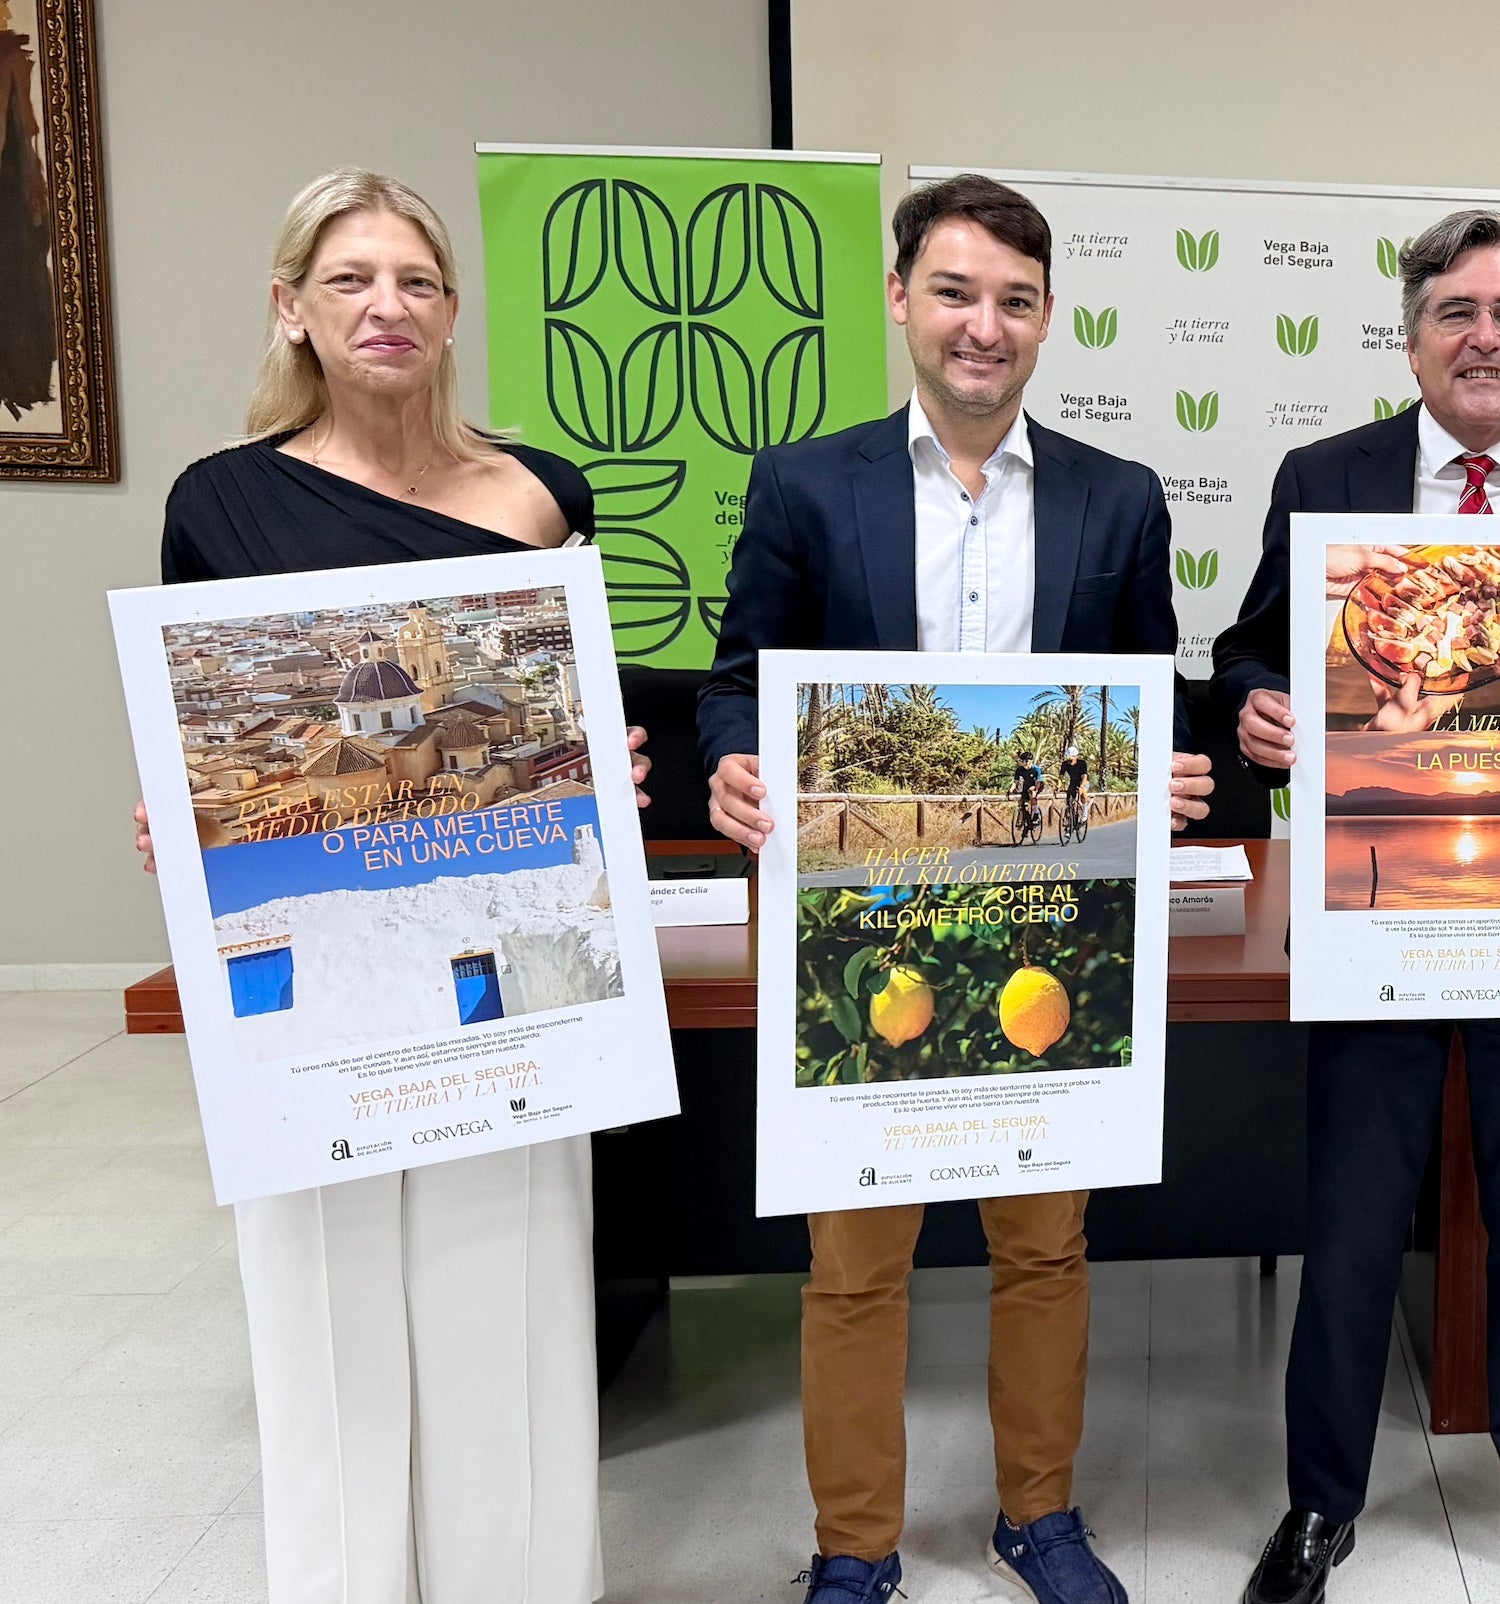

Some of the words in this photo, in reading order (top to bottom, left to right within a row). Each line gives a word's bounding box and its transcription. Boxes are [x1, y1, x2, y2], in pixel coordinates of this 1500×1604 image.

[1089, 232, 1128, 245] tierra
[1264, 240, 1296, 252] Vega
[1300, 241, 1329, 254] Baja
[1066, 248, 1075, 259] y
[1080, 246, 1092, 258] la
[1096, 246, 1122, 258] mía
[1264, 254, 1284, 266] del
[1288, 255, 1333, 268] Segura
[1192, 318, 1229, 330] tierra
[1362, 324, 1394, 337] Vega
[1168, 334, 1178, 344] y
[1182, 332, 1194, 342] la
[1199, 332, 1224, 344] mía
[1362, 338, 1382, 350] del
[1060, 394, 1093, 406] Vega
[1098, 395, 1128, 408] Baja
[1291, 402, 1328, 414] tierra
[1060, 408, 1080, 420] del
[1085, 409, 1132, 422] Segura
[1270, 416, 1278, 427] y
[1282, 414, 1294, 426] la
[1298, 414, 1322, 426] mía
[1162, 476, 1194, 489] Vega
[1199, 478, 1228, 490] Baja
[714, 491, 747, 509] Veg
[1164, 490, 1182, 502] del
[1187, 491, 1232, 504] Segura
[715, 511, 744, 525] del
[1431, 695, 1466, 714] EN
[1430, 714, 1460, 732] LA
[1417, 753, 1444, 770] LA
[238, 794, 312, 822] PARA
[322, 779, 414, 811] ESTAR
[429, 772, 466, 797] EN
[242, 809, 343, 842] MEDIO
[351, 803, 389, 828] DE
[400, 792, 482, 822] TODO
[322, 833, 344, 854] O
[352, 820, 432, 850] PARA
[434, 802, 564, 836] METERTE
[364, 849, 403, 871] EN
[412, 838, 470, 865] UNA
[476, 824, 568, 853] CUEVA
[864, 846, 950, 867] HACER
[862, 867, 911, 886] MIL
[916, 860, 1080, 885] KILÓMETROS
[650, 886, 676, 895] ández
[678, 886, 708, 894] Cecilia
[996, 886, 1014, 905] O
[1022, 885, 1045, 903] IR
[1050, 884, 1080, 902] AL
[859, 902, 1004, 930] KILÓMETRO
[1010, 904, 1080, 924] CERO
[1401, 949, 1434, 959] VEGA
[1438, 948, 1466, 958] BAJA
[1470, 948, 1492, 958] DEL
[368, 1069, 376, 1077] lo
[378, 1068, 392, 1076] que
[394, 1064, 414, 1072] tiene
[415, 1060, 431, 1068] vivir
[460, 1050, 480, 1060] tierra
[482, 1048, 494, 1056] tan
[350, 1088, 394, 1105] VEGA
[399, 1080, 436, 1096] BAJA
[440, 1073, 470, 1088] DEL
[474, 1060, 541, 1082] SEGURA.
[352, 1105, 378, 1120] TU
[384, 1090, 450, 1114] TIERRA
[457, 1085, 468, 1100] Y
[475, 1081, 498, 1097] LA
[412, 1118, 493, 1145] CONVEGA
[884, 1124, 921, 1137] VEGA
[926, 1122, 958, 1134] BAJA
[962, 1119, 988, 1131] DEL
[992, 1115, 1050, 1129] SEGURA.
[884, 1138, 904, 1151] TU
[911, 1134, 970, 1149] TIERRA
[973, 1132, 982, 1144] Y
[988, 1130, 1010, 1142] LA
[930, 1164, 1000, 1182] CONVEGA
